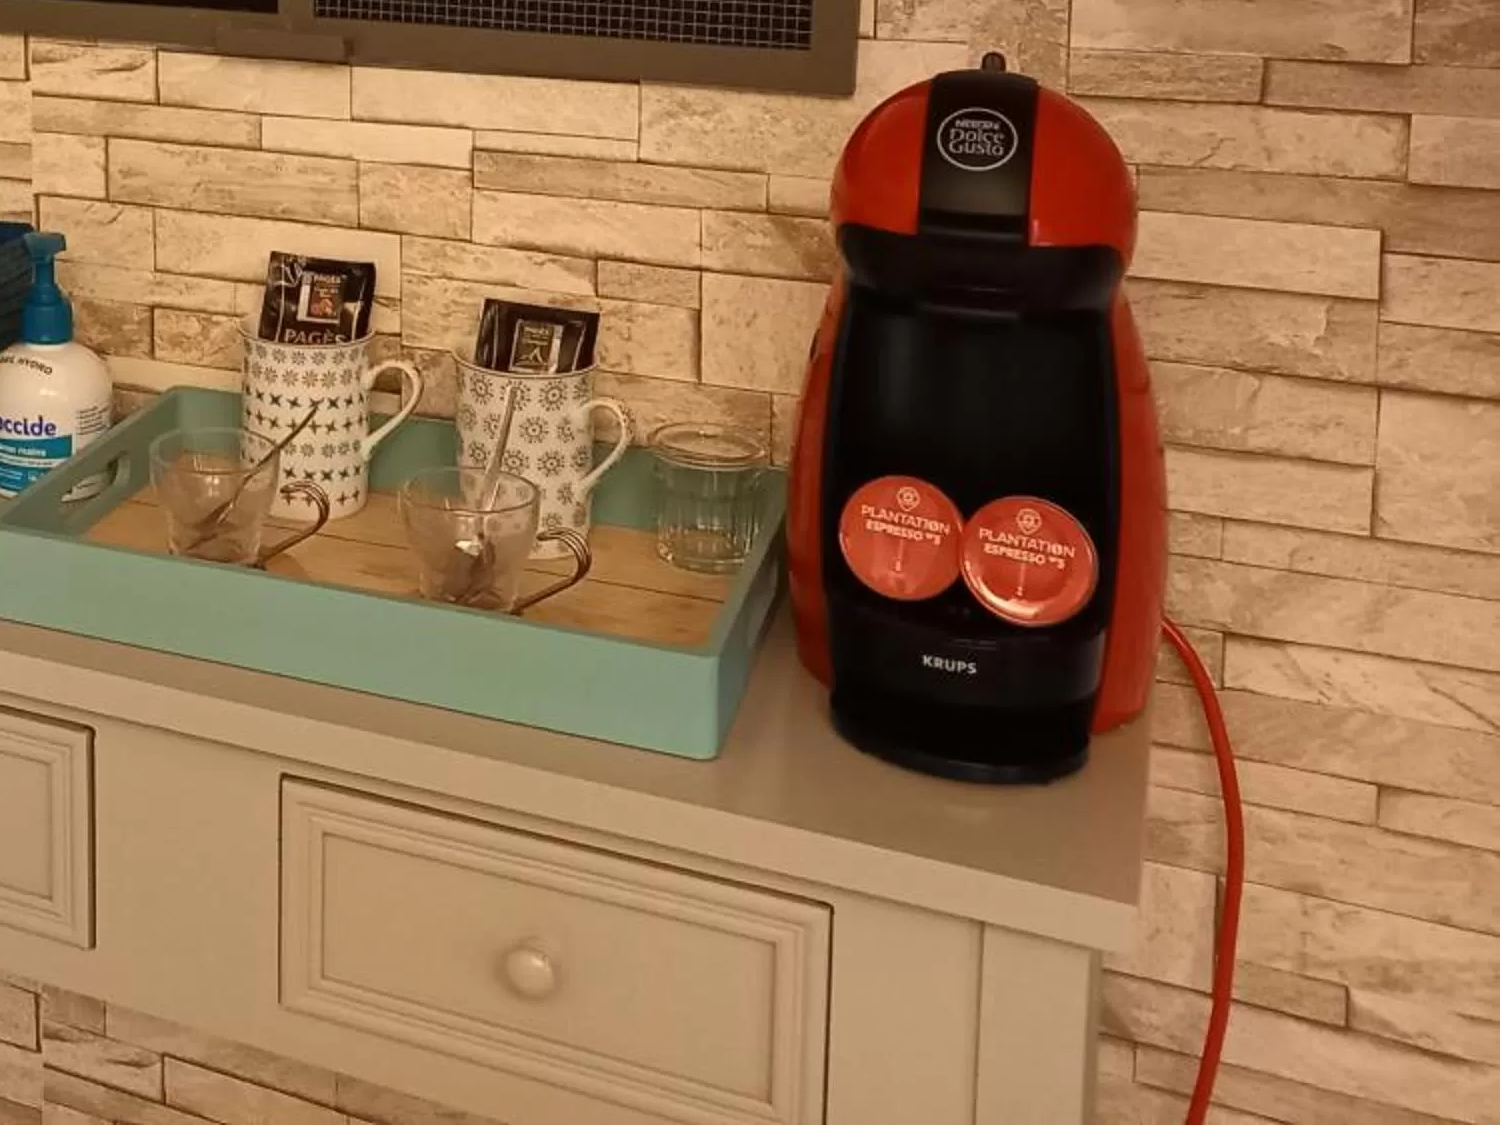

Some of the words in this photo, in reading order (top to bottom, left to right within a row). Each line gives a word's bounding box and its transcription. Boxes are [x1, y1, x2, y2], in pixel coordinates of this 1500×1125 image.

[951, 128, 1005, 144] Dolce
[861, 504, 951, 535] PLANTATION
[866, 519, 923, 541] ESPRESSO
[979, 528, 1075, 558] PLANTATION
[984, 542, 1046, 565] ESPRESSO
[922, 654, 977, 674] KRUPS
